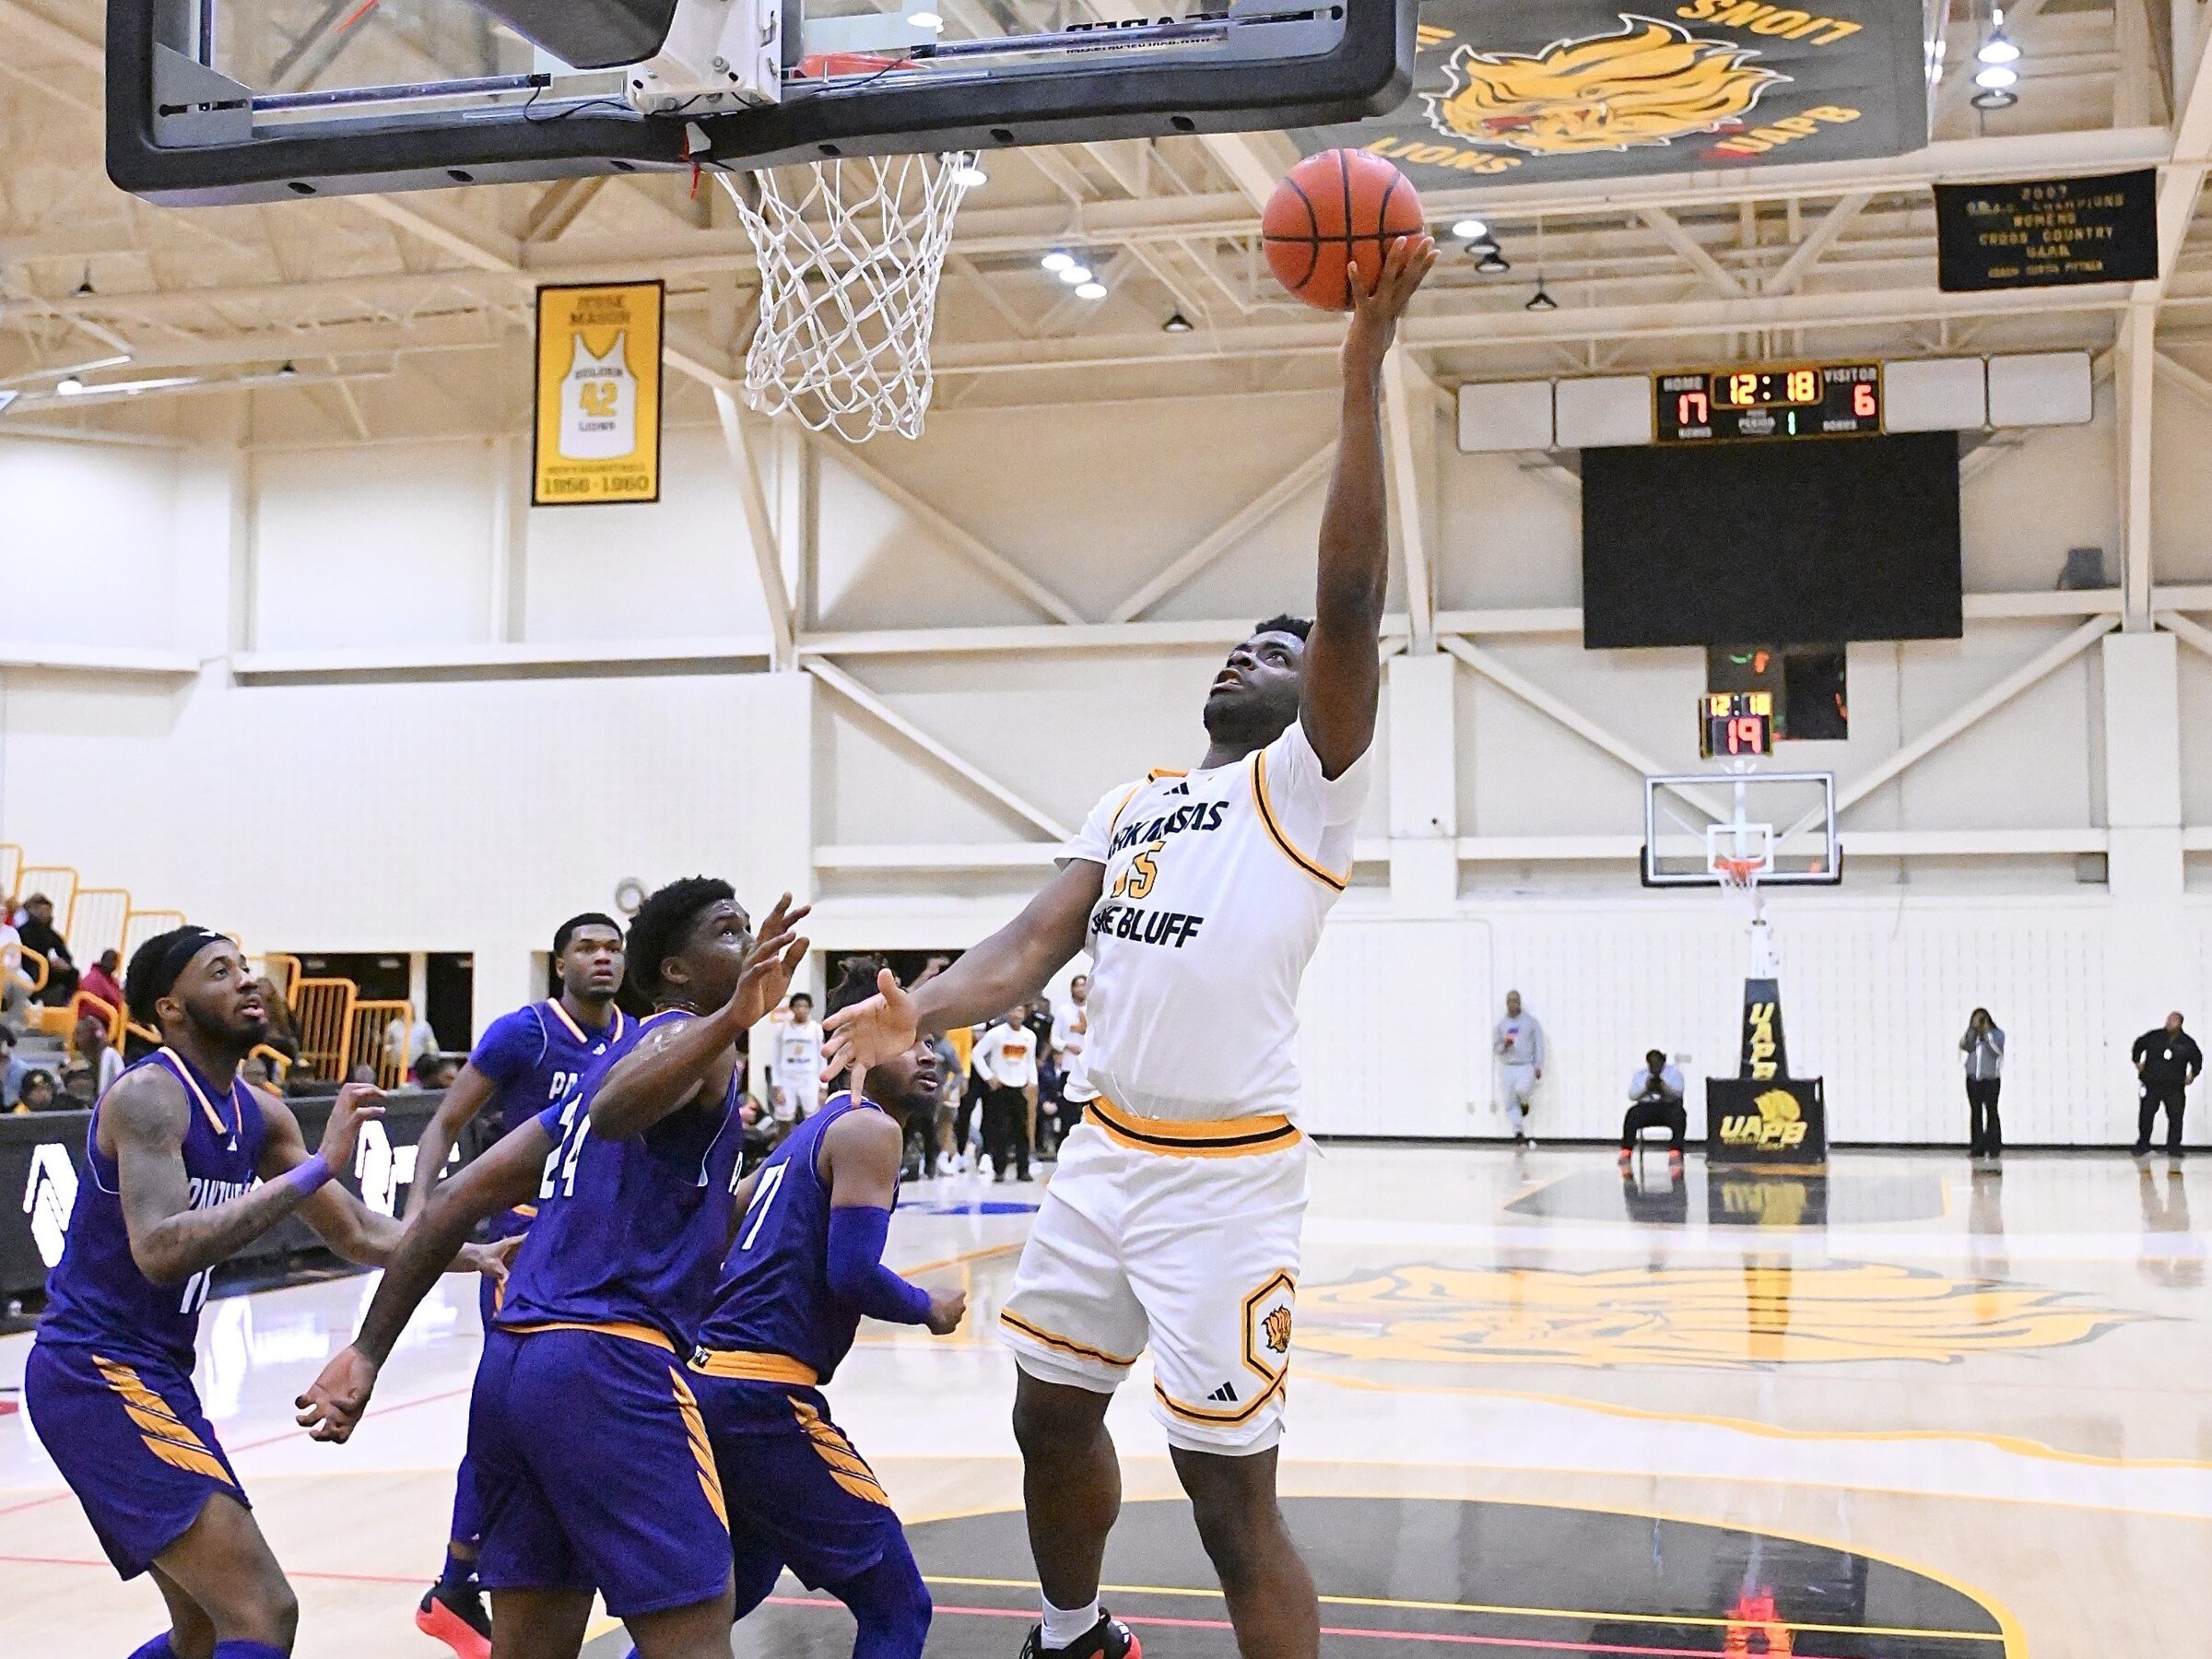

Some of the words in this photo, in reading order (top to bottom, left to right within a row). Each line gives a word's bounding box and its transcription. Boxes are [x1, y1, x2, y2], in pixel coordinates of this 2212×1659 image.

[1715, 105, 1862, 154] UAPB
[578, 381, 618, 418] 42
[1678, 393, 1707, 425] 17
[1853, 383, 1876, 416] 6
[1729, 371, 1815, 406] 12:18
[1728, 718, 1761, 754] 19
[1116, 906, 1205, 948] BLUFF
[1749, 1002, 1778, 1080] UAPB
[539, 1093, 592, 1199] 24
[1719, 1115, 1808, 1145] UAPB
